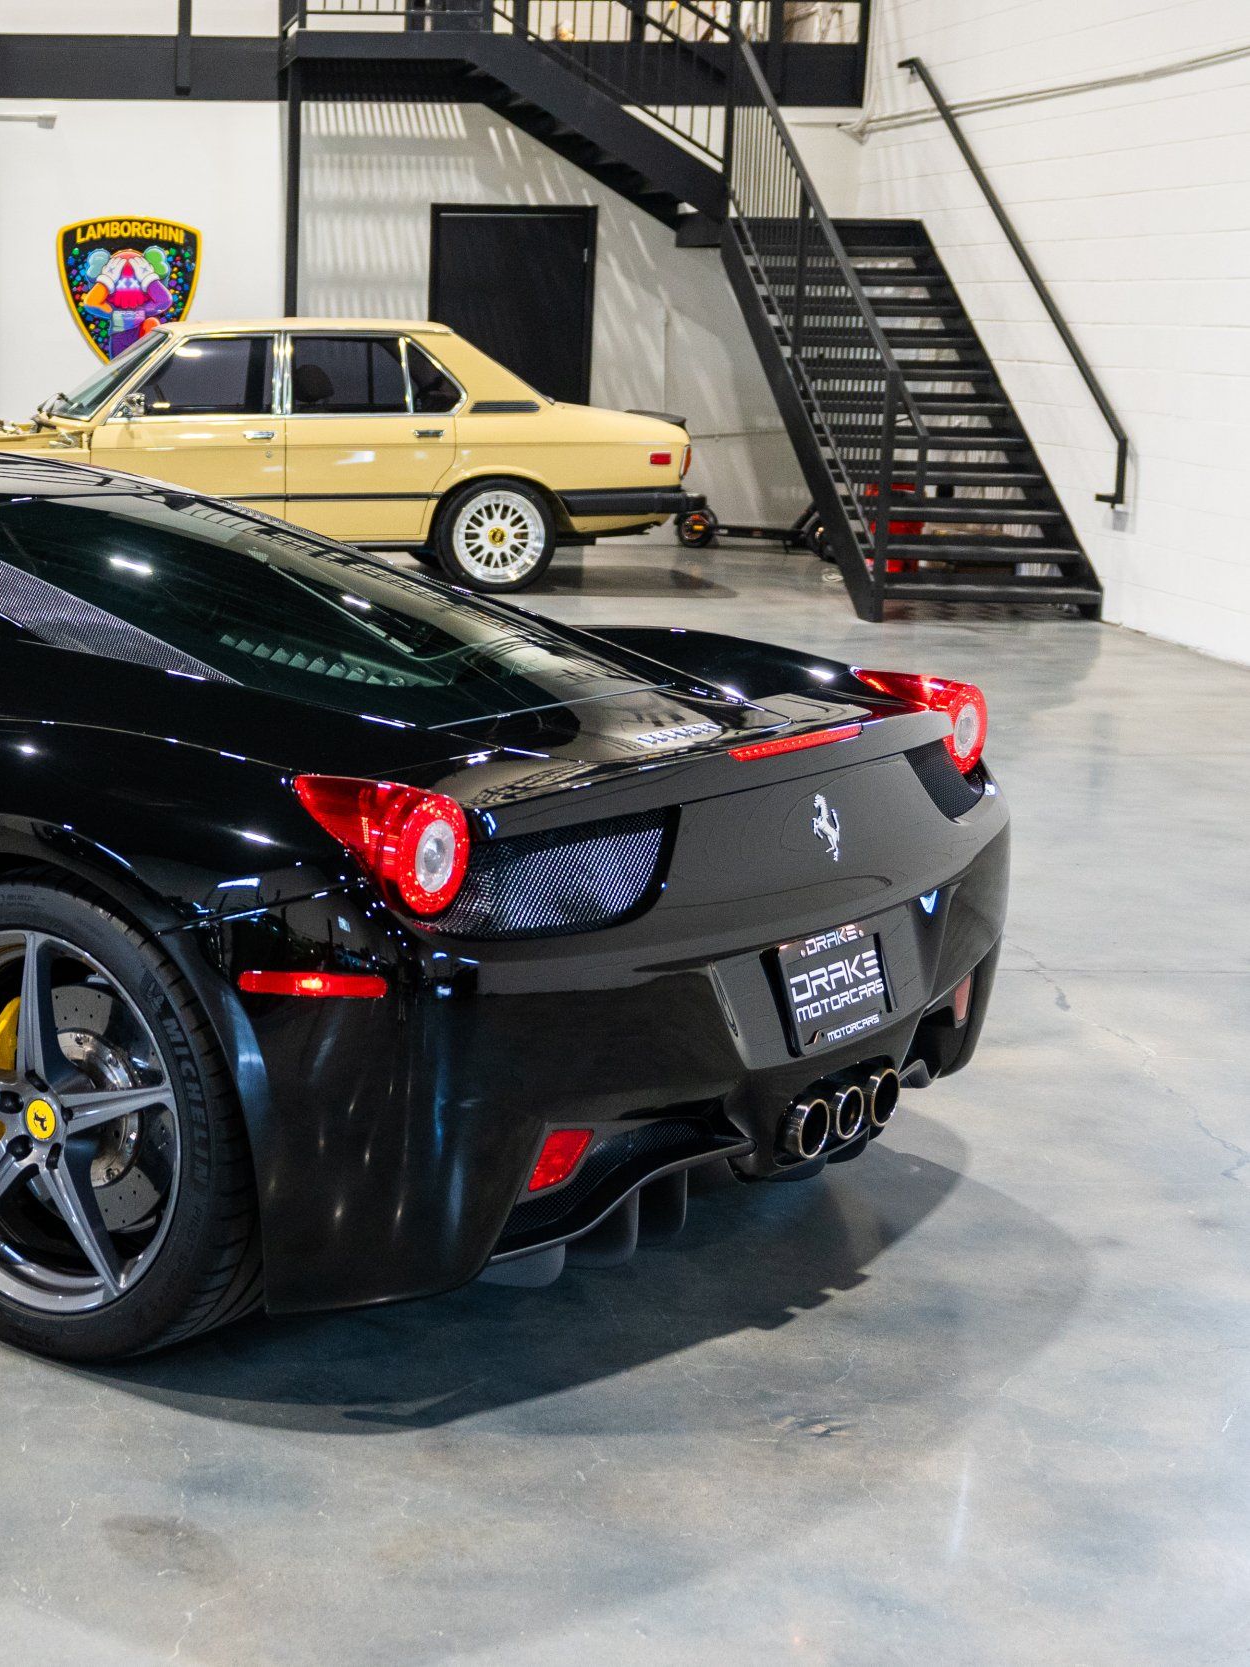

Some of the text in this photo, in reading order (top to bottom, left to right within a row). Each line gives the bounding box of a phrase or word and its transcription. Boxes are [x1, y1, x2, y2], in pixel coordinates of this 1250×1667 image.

[75, 221, 185, 245] LAMBORGHINI
[805, 924, 858, 956] DRAKE
[789, 949, 881, 1003] DRAKE
[795, 978, 885, 1023] MOTORCARS
[826, 1013, 880, 1042] MOTORCARS
[161, 1014, 209, 1184] MICHELIN
